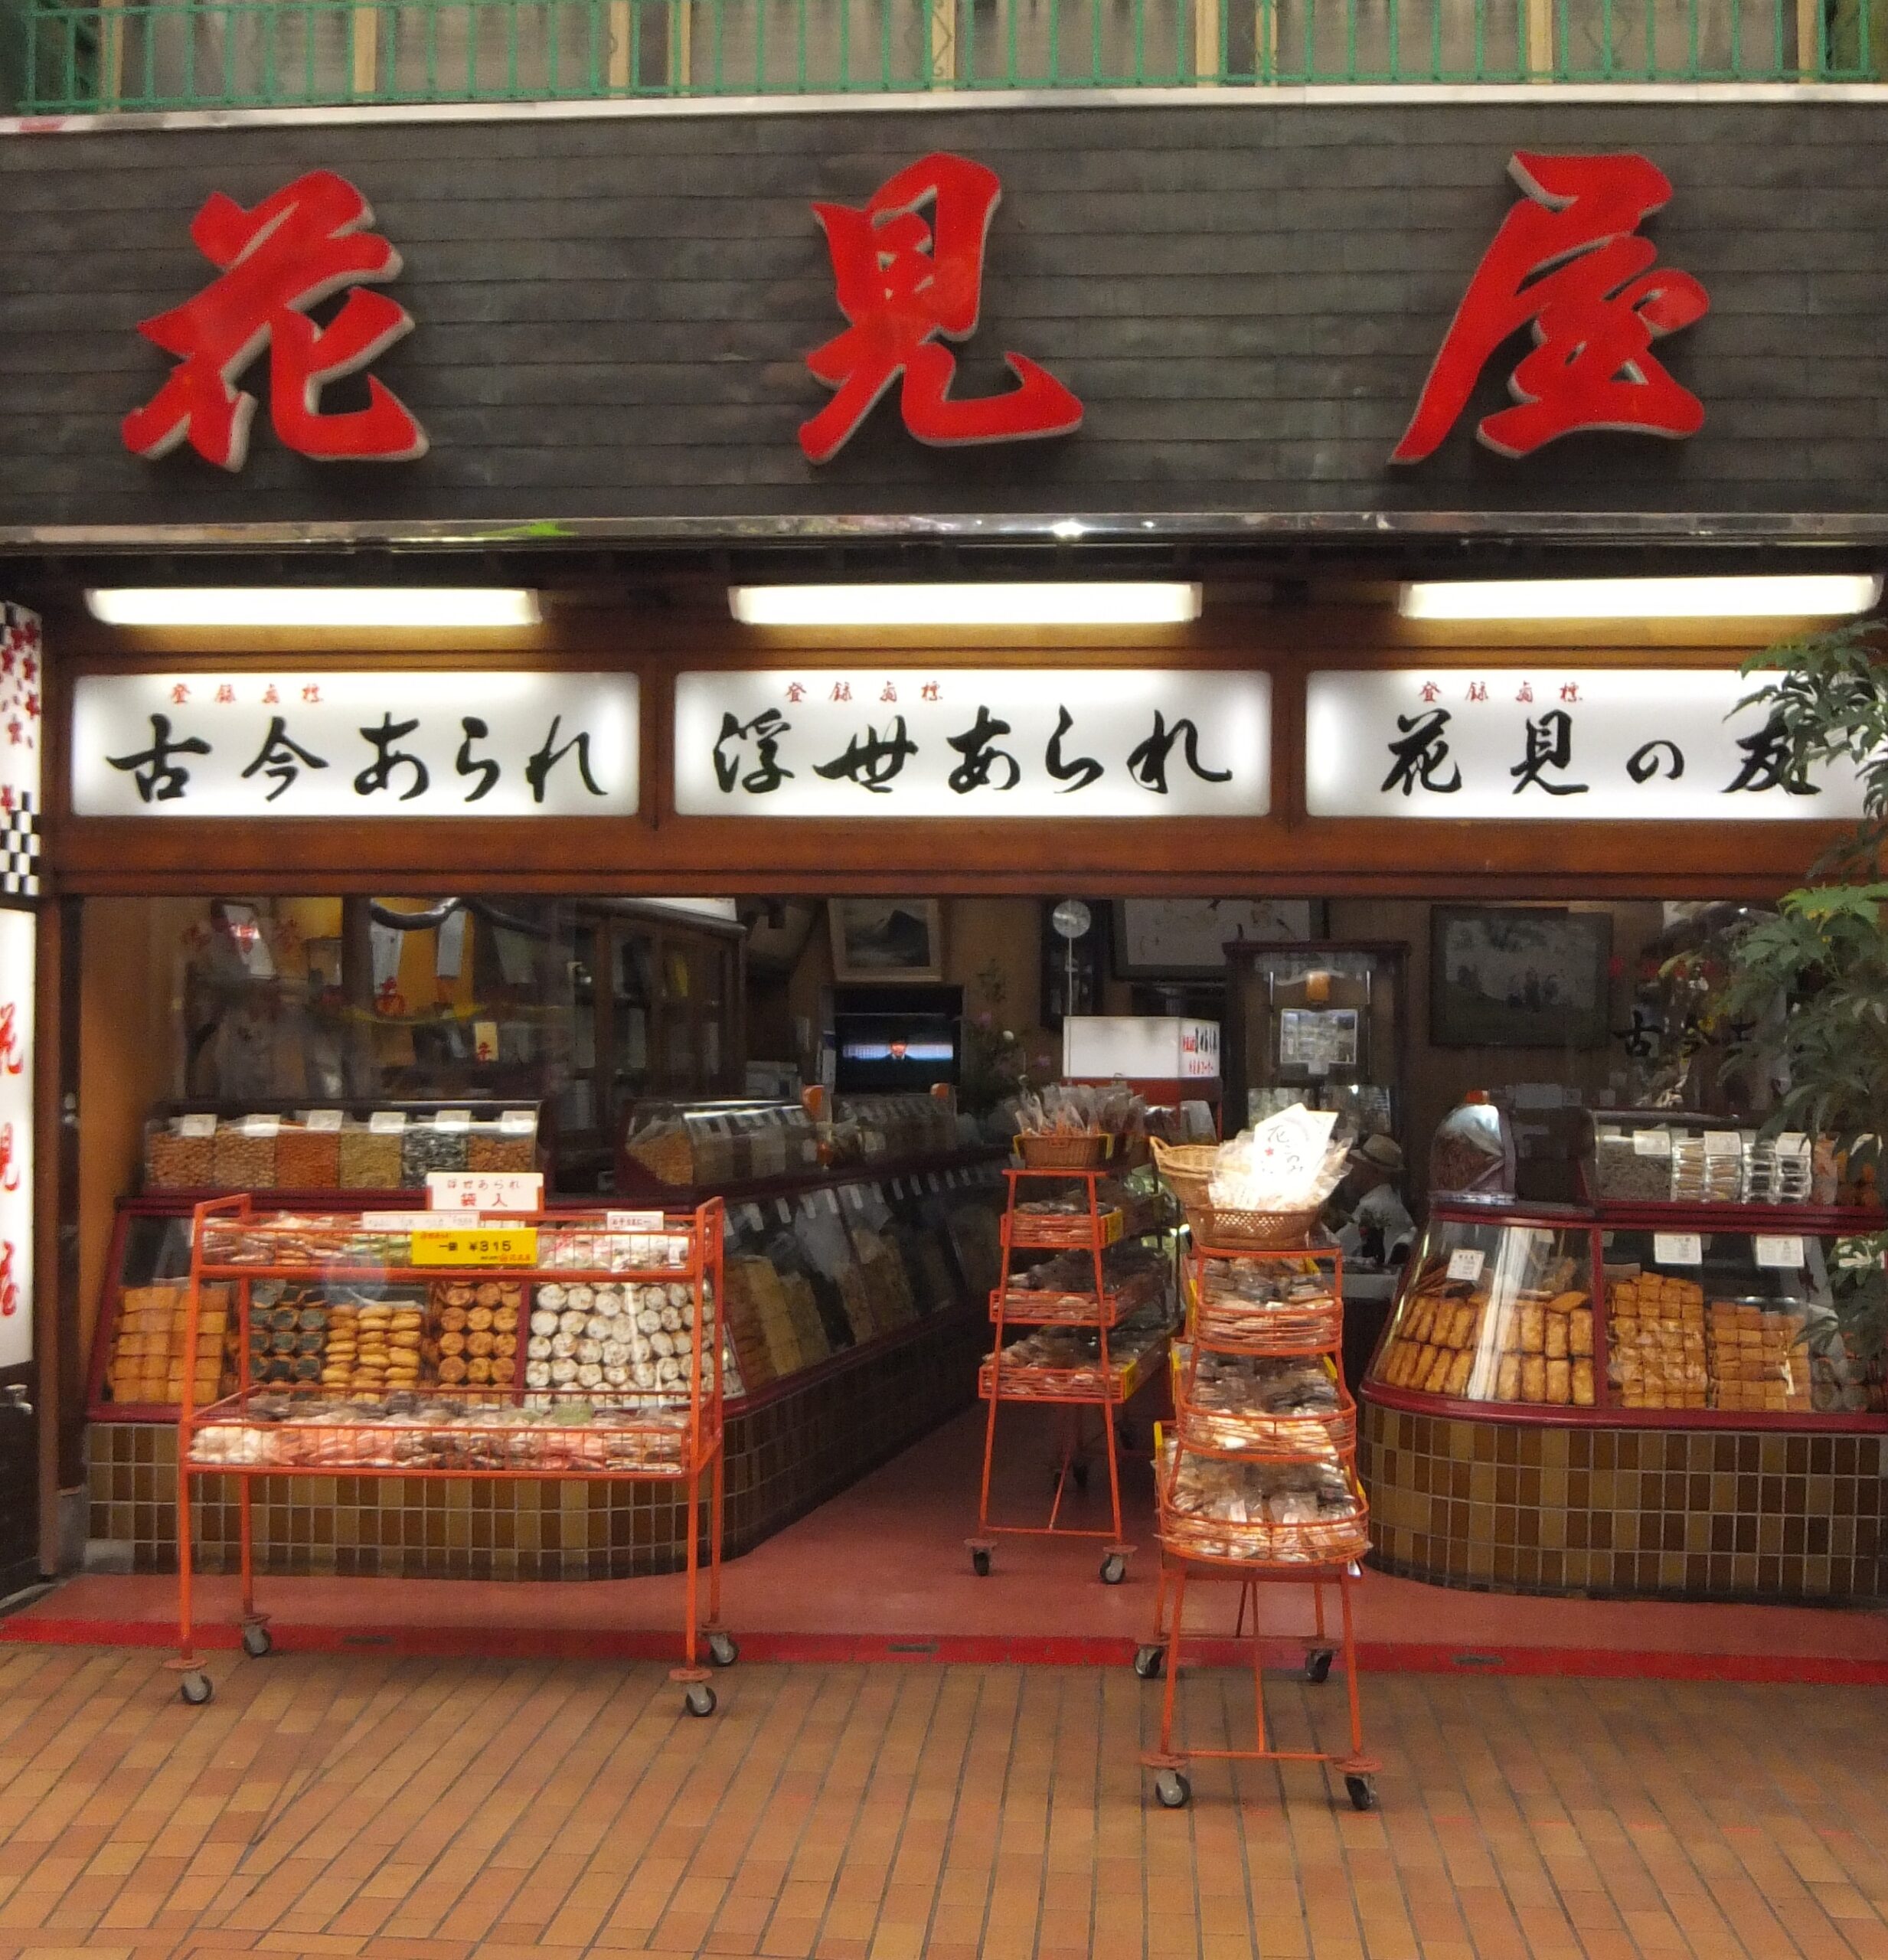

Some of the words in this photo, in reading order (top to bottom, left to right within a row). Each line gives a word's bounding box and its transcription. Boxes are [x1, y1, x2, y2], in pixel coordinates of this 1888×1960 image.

[123, 153, 1709, 469] 花見屋
[106, 712, 608, 804] 古今あられ
[713, 704, 1233, 795] 浮世あられ
[1381, 709, 1822, 796] 花見の友
